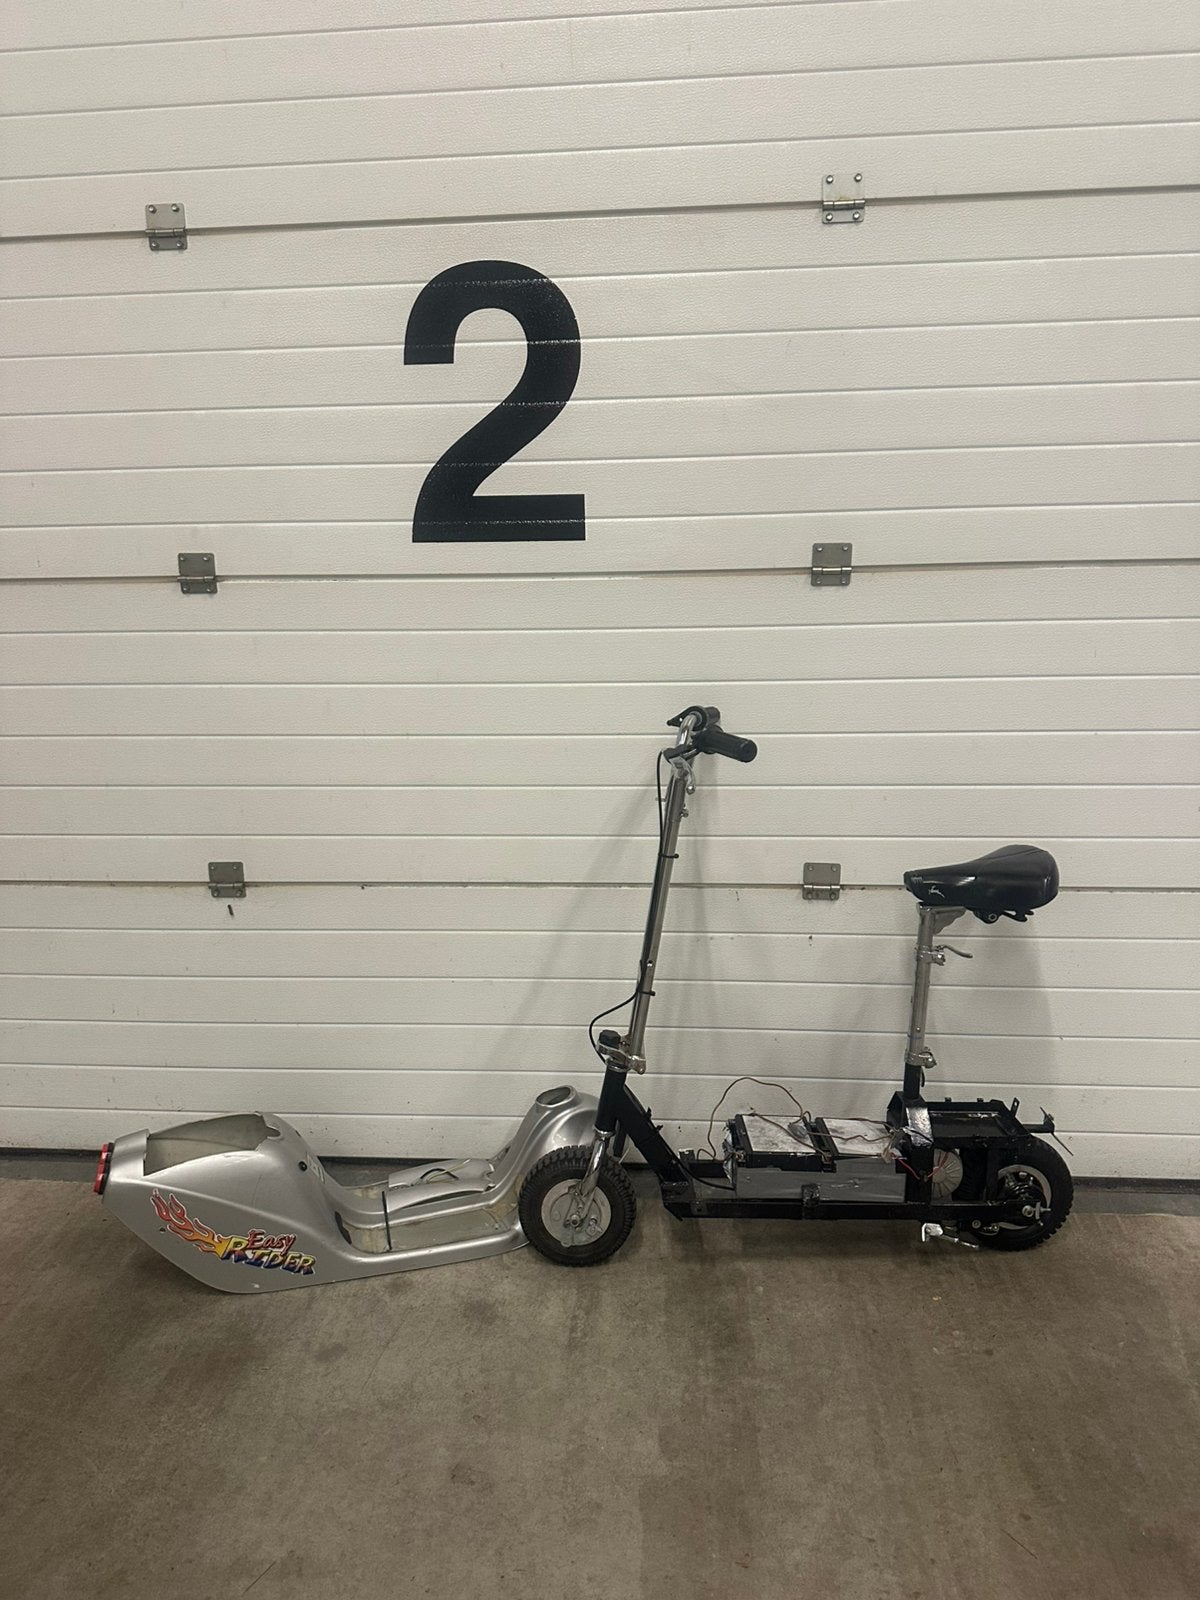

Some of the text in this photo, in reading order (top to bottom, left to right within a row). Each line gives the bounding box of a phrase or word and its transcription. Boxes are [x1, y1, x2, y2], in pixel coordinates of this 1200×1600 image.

[404, 260, 586, 542] 2
[222, 1237, 315, 1275] RIDER
[248, 1229, 297, 1256] Easy
